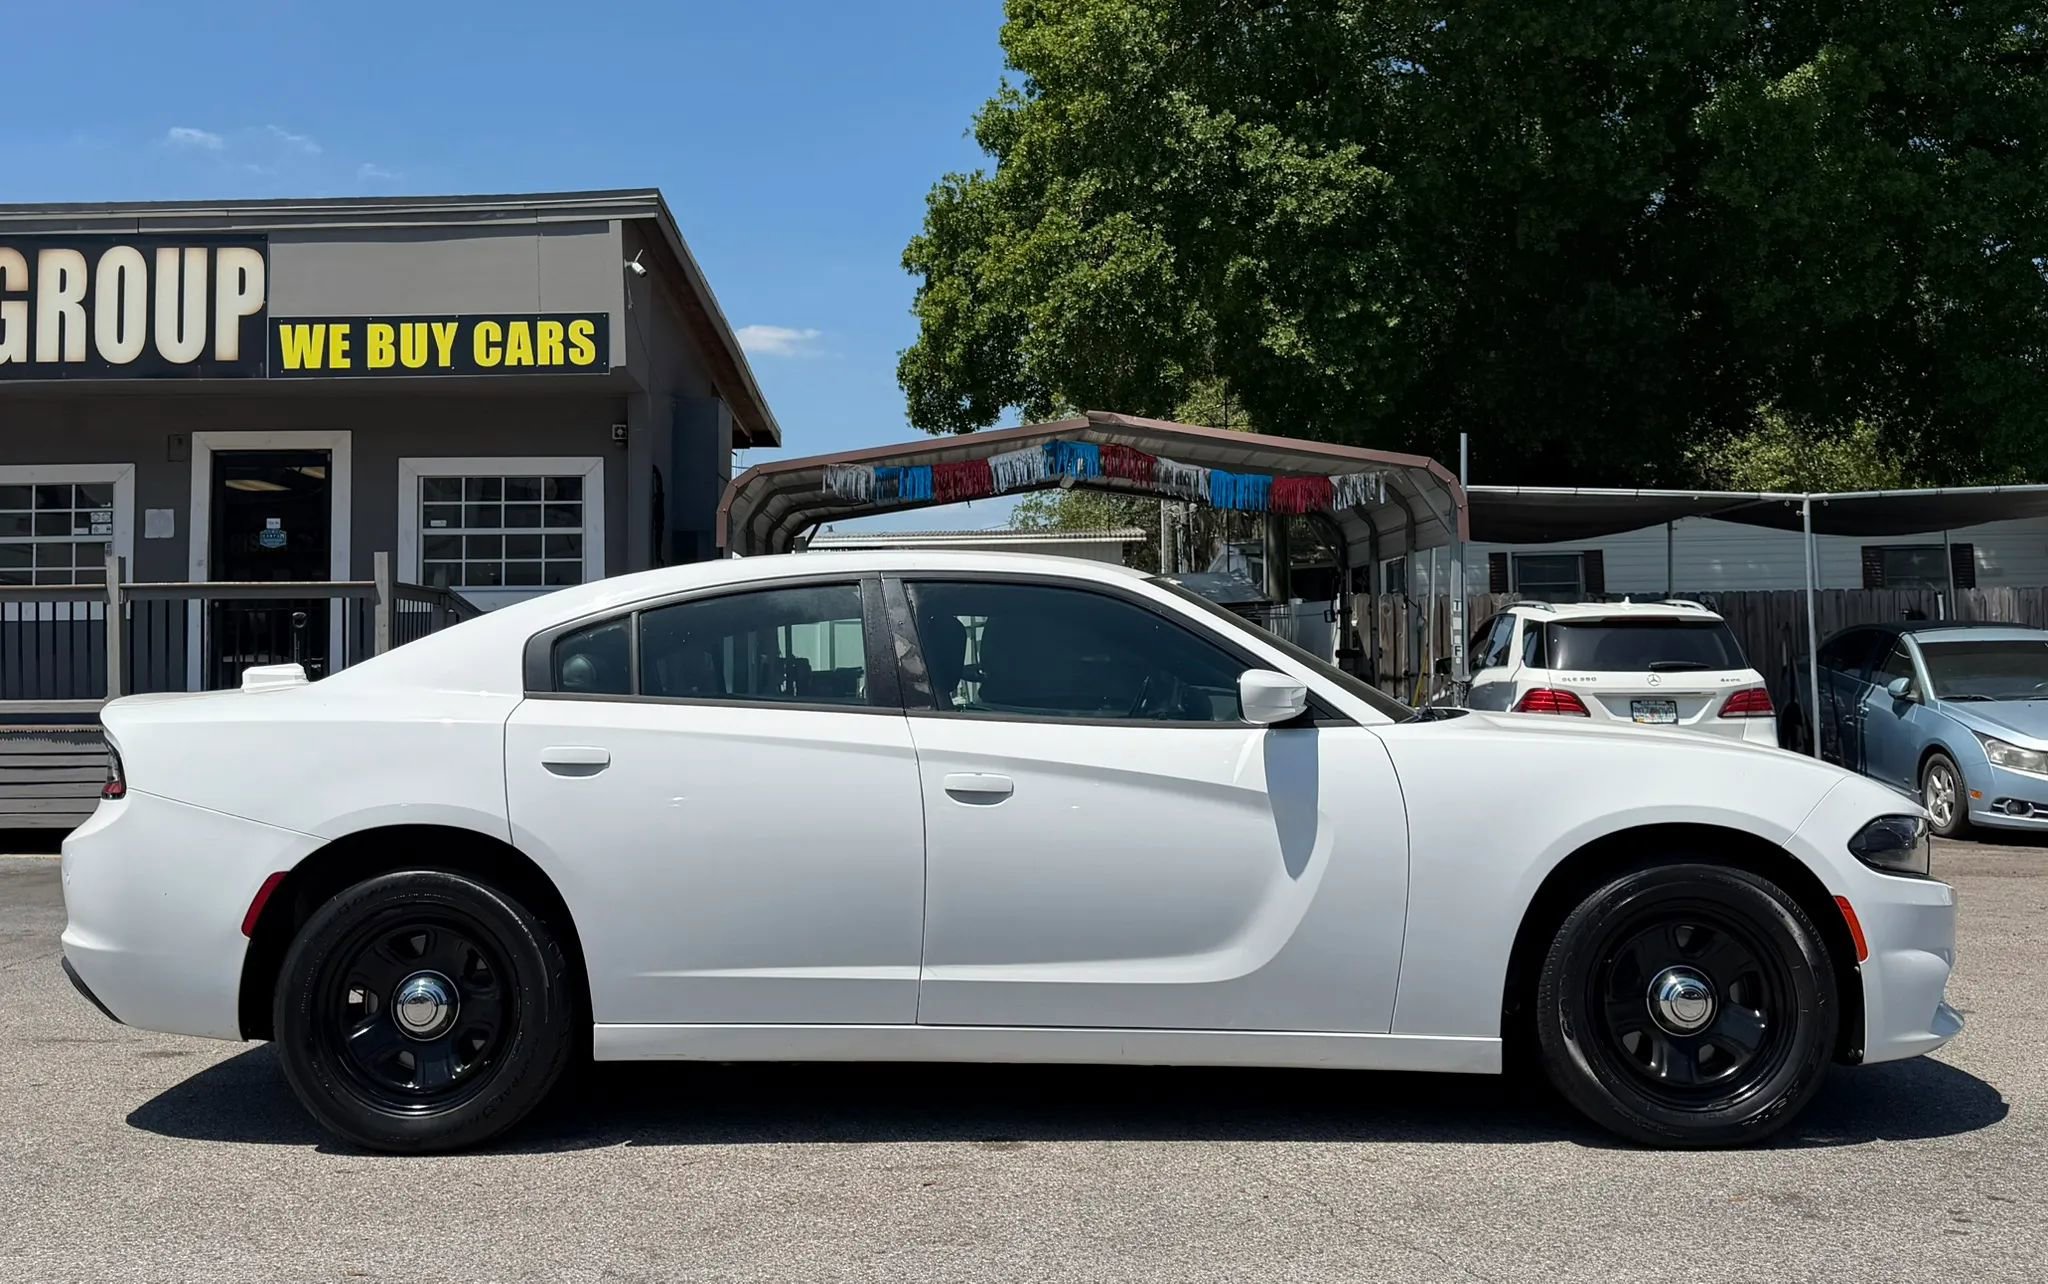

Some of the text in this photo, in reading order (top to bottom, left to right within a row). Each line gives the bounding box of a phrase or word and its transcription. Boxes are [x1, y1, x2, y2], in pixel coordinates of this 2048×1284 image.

[0, 245, 266, 365] GROUP
[279, 319, 597, 370] WE BUY CARS
